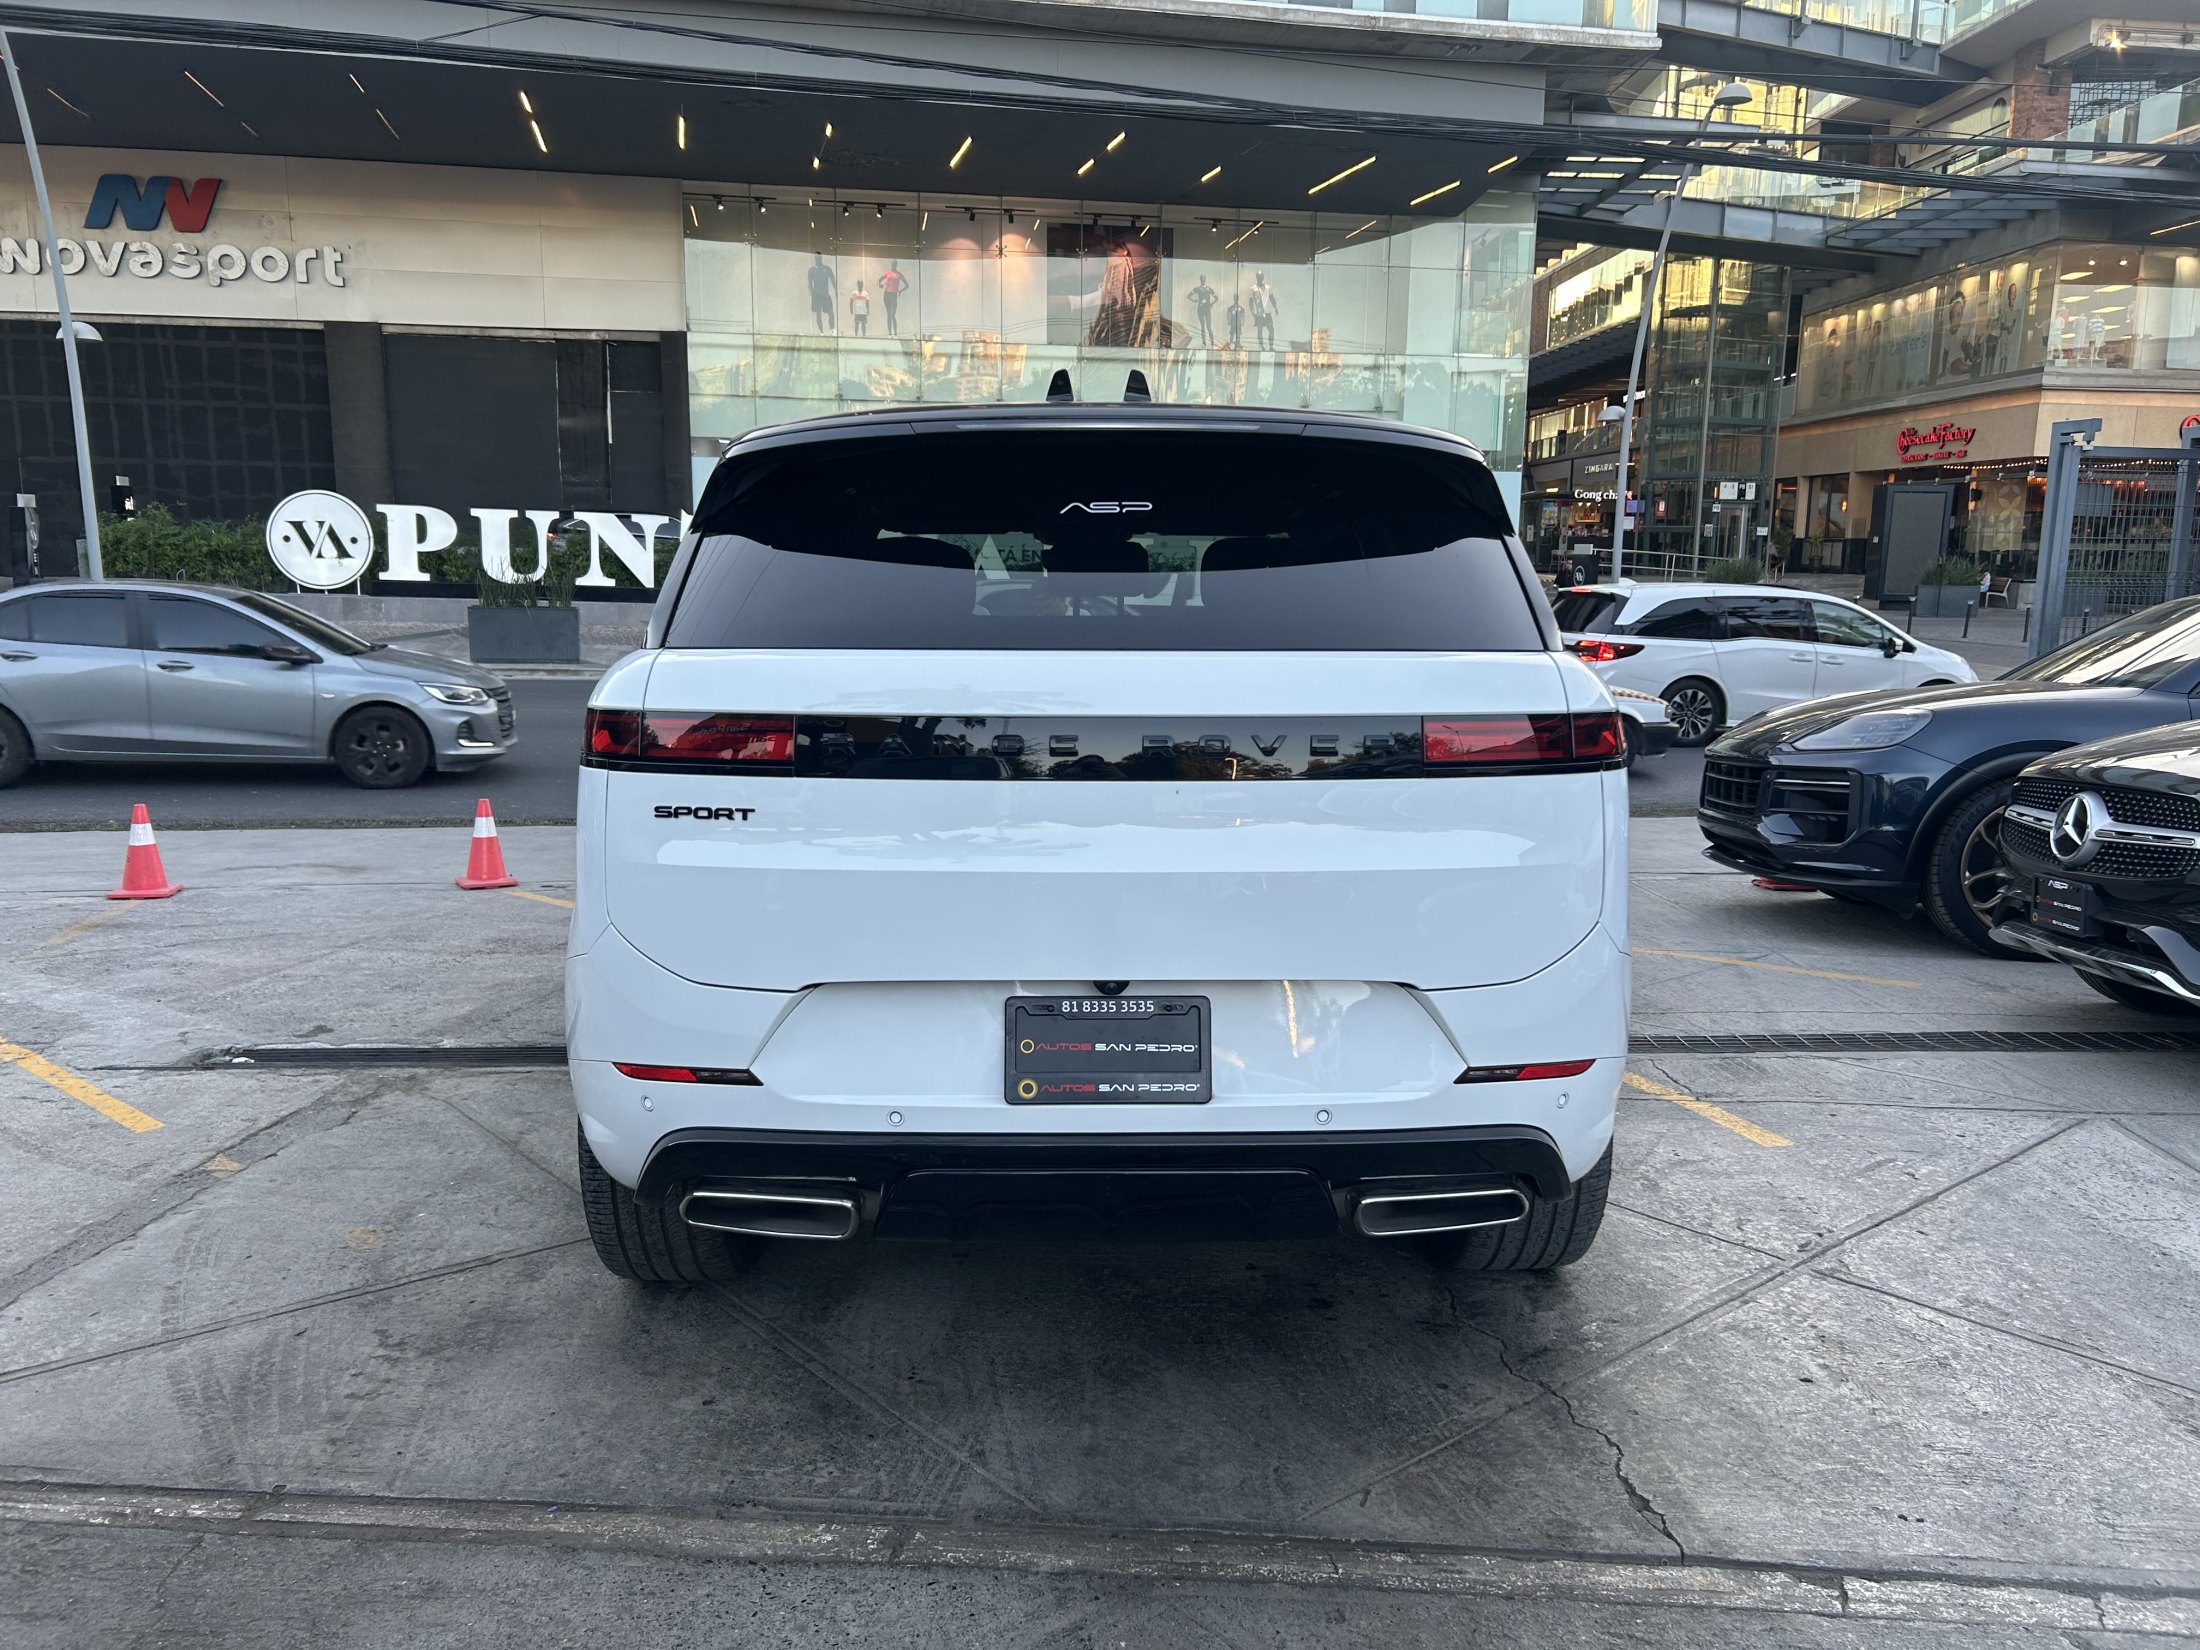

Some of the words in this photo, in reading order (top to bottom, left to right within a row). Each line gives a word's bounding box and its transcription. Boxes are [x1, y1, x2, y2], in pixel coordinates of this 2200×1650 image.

[1937, 422, 1976, 449] Factory
[1584, 463, 1613, 474] ZINGARA
[1574, 489, 1602, 502] Gong
[1060, 501, 1153, 514] ASP
[376, 503, 693, 589] PUN
[820, 732, 1079, 758] RANGE
[1141, 733, 1396, 758] ROVER
[653, 805, 756, 821] SPORT
[1061, 1000, 1079, 1012] 81
[1082, 1000, 1117, 1012] 8335
[1120, 1000, 1155, 1012] 3535
[1035, 1042, 1093, 1052] AUTOS
[1094, 1043, 1132, 1052] SAN
[1040, 1083, 1097, 1093] AUTOS
[1098, 1083, 1135, 1092] SAN
